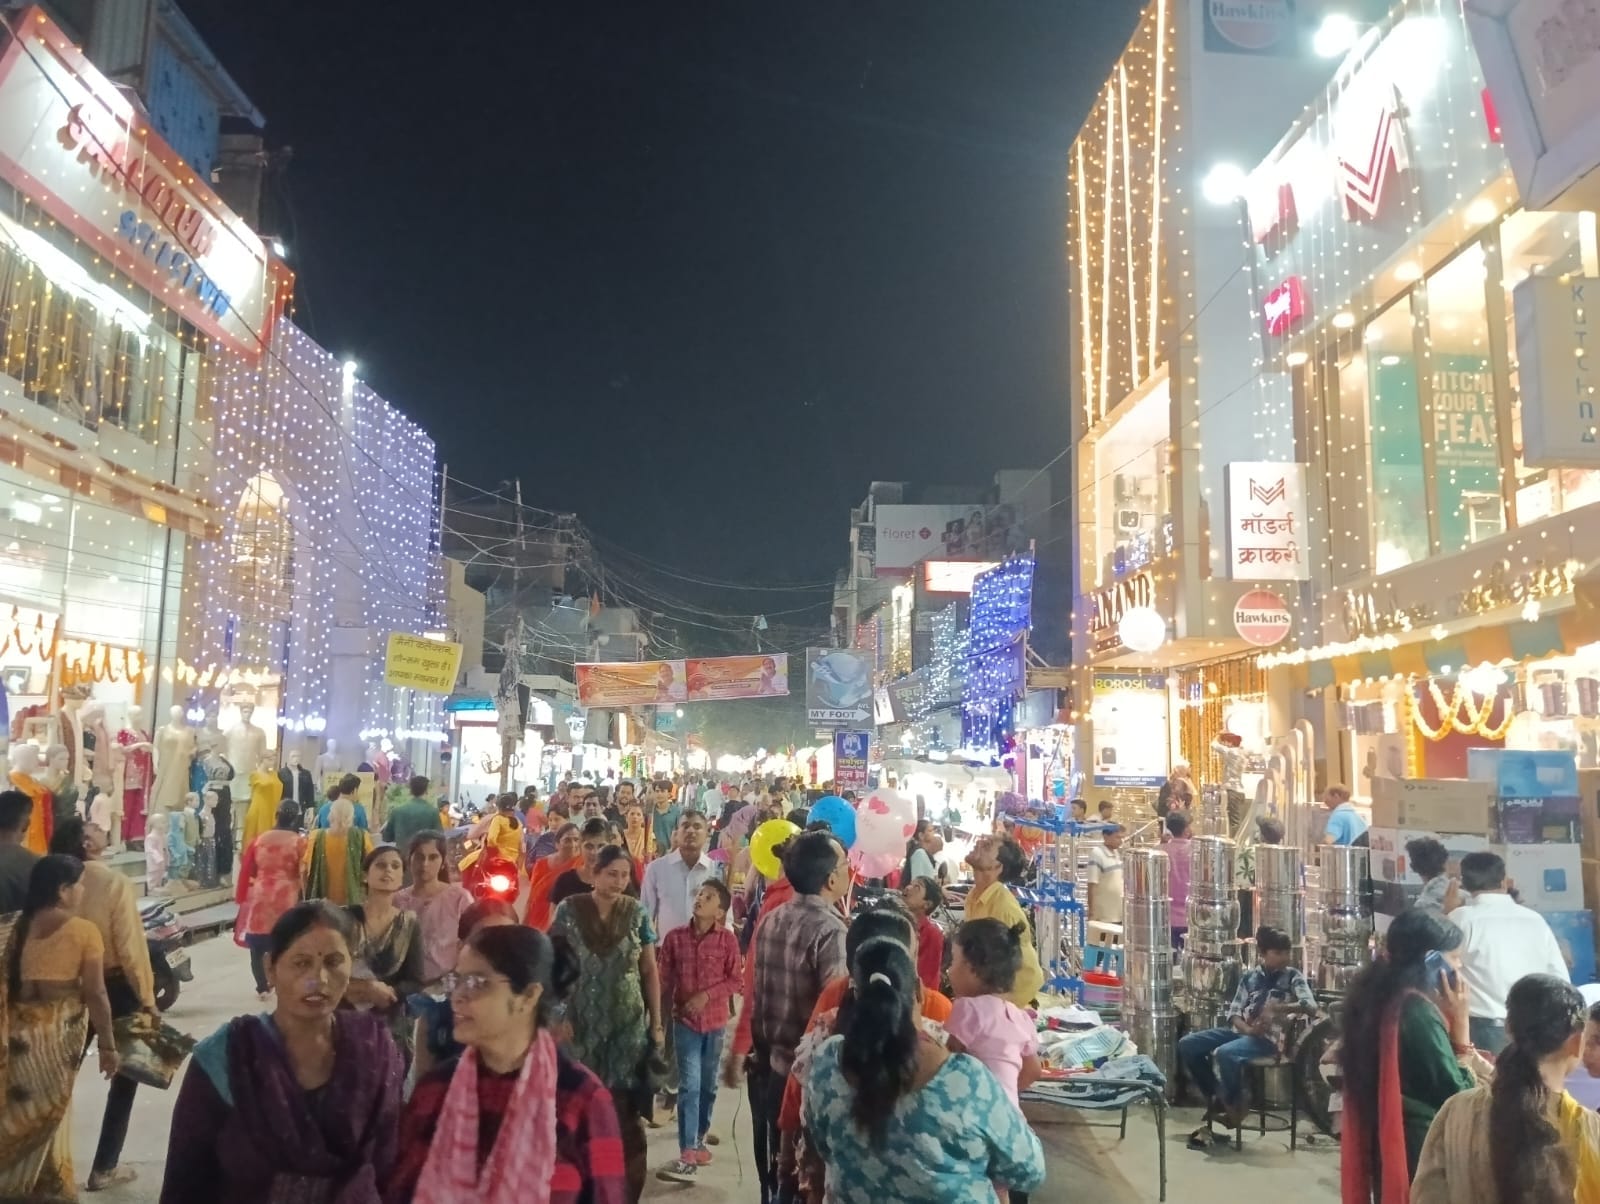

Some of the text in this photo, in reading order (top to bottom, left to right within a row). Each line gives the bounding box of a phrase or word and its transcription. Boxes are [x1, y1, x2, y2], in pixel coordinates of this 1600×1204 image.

[1240, 512, 1295, 535] मॉडर्न
[882, 527, 915, 540] floret
[1235, 611, 1290, 624] Hawkins
[1094, 679, 1148, 690] BOROSIL
[810, 710, 857, 719] MY FOOT
